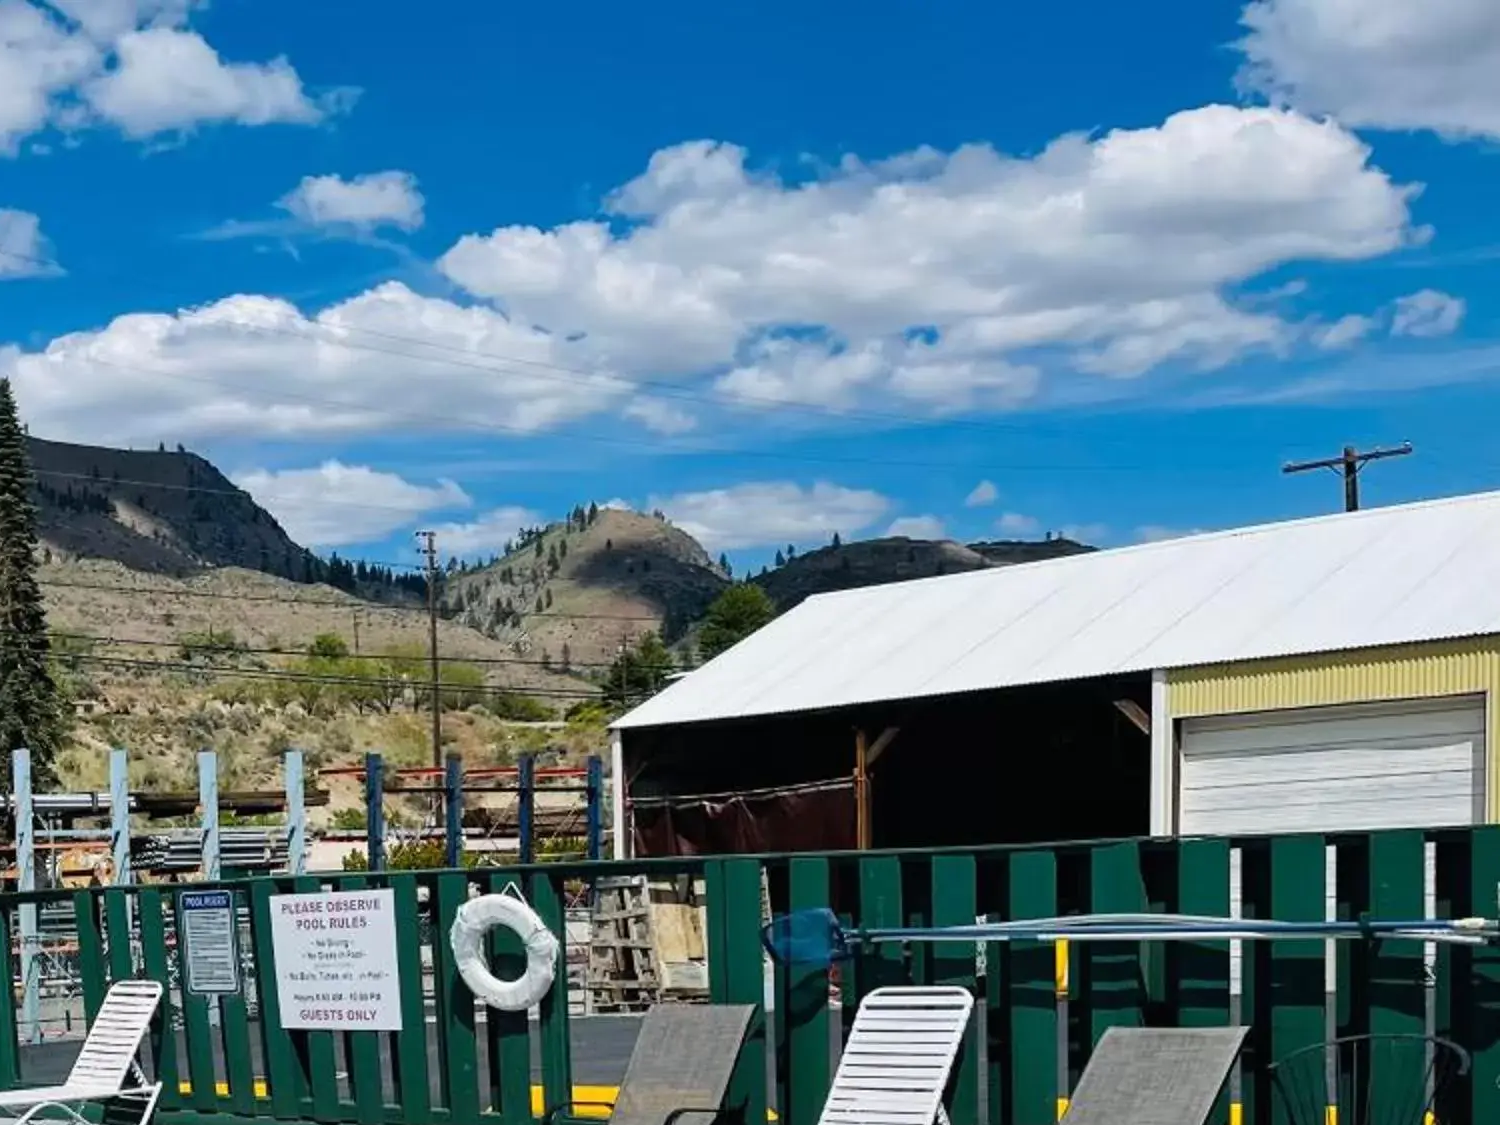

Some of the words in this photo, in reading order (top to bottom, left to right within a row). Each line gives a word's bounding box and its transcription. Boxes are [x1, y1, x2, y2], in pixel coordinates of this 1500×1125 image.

[281, 901, 324, 915] PLEASE
[326, 898, 382, 913] OBSERVE
[295, 918, 327, 930] POOL
[329, 916, 368, 929] RULES
[300, 1009, 343, 1021] GUESTS
[346, 1009, 377, 1021] ONLY
